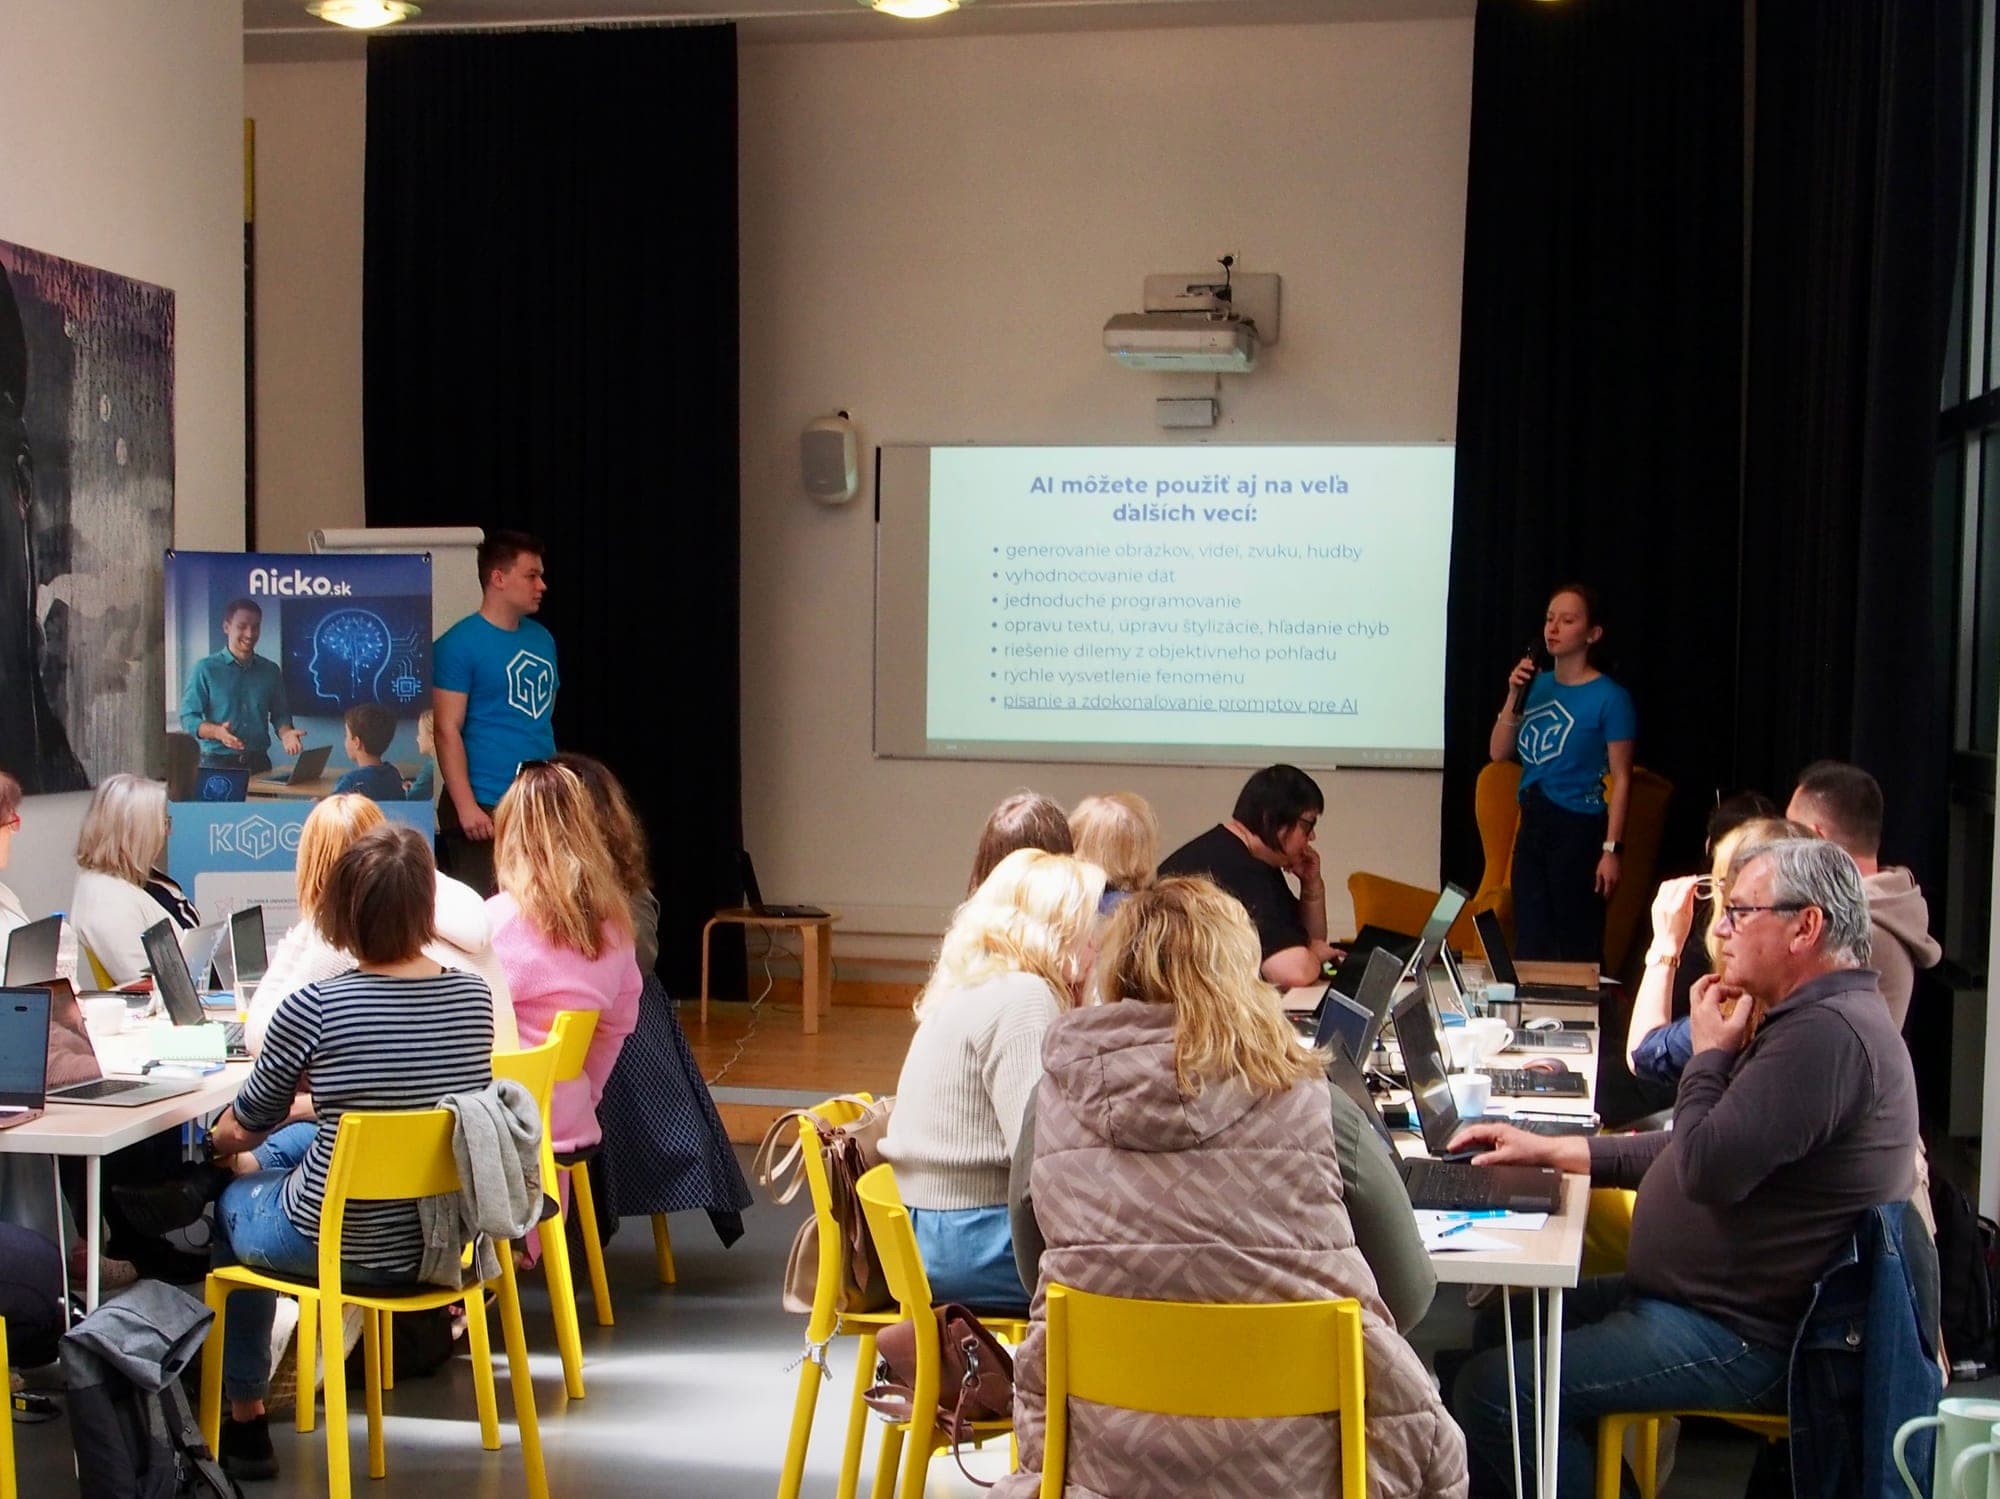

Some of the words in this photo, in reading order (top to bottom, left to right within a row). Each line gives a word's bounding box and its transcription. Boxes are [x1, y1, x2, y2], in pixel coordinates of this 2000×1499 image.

[1030, 476, 1053, 494] AI
[1061, 474, 1148, 494] môžete
[1155, 474, 1230, 497] použiť
[1237, 475, 1257, 498] aj
[1265, 480, 1292, 494] na
[1300, 476, 1349, 494] veľa
[1112, 503, 1195, 521] ďalších
[1203, 504, 1257, 522] vecí:
[1005, 543, 1110, 559] generovanie
[1115, 543, 1194, 559] obrázkov,
[1247, 544, 1301, 559] zvuku,
[1307, 544, 1362, 562] hudby
[1005, 568, 1143, 585] vyhodnocovanie
[1003, 593, 1106, 610] jednoduché
[1111, 594, 1241, 611] programovanie
[1004, 620, 1062, 635] opravu
[1068, 620, 1114, 634] textu,
[1119, 619, 1178, 636] úpravu
[1268, 619, 1343, 636] hľadanie
[1004, 644, 1069, 658] riešenie
[1073, 644, 1132, 660] dilemy
[1265, 646, 1337, 662] pohľadu
[1003, 668, 1054, 685] rýchle
[1058, 668, 1151, 686] vysvetlenie
[1156, 669, 1245, 685] fenoménu
[1081, 694, 1214, 711] zdokonaľovanie
[1217, 697, 1303, 713] promptov
[1308, 699, 1337, 714] pre
[1340, 698, 1359, 714] AI
